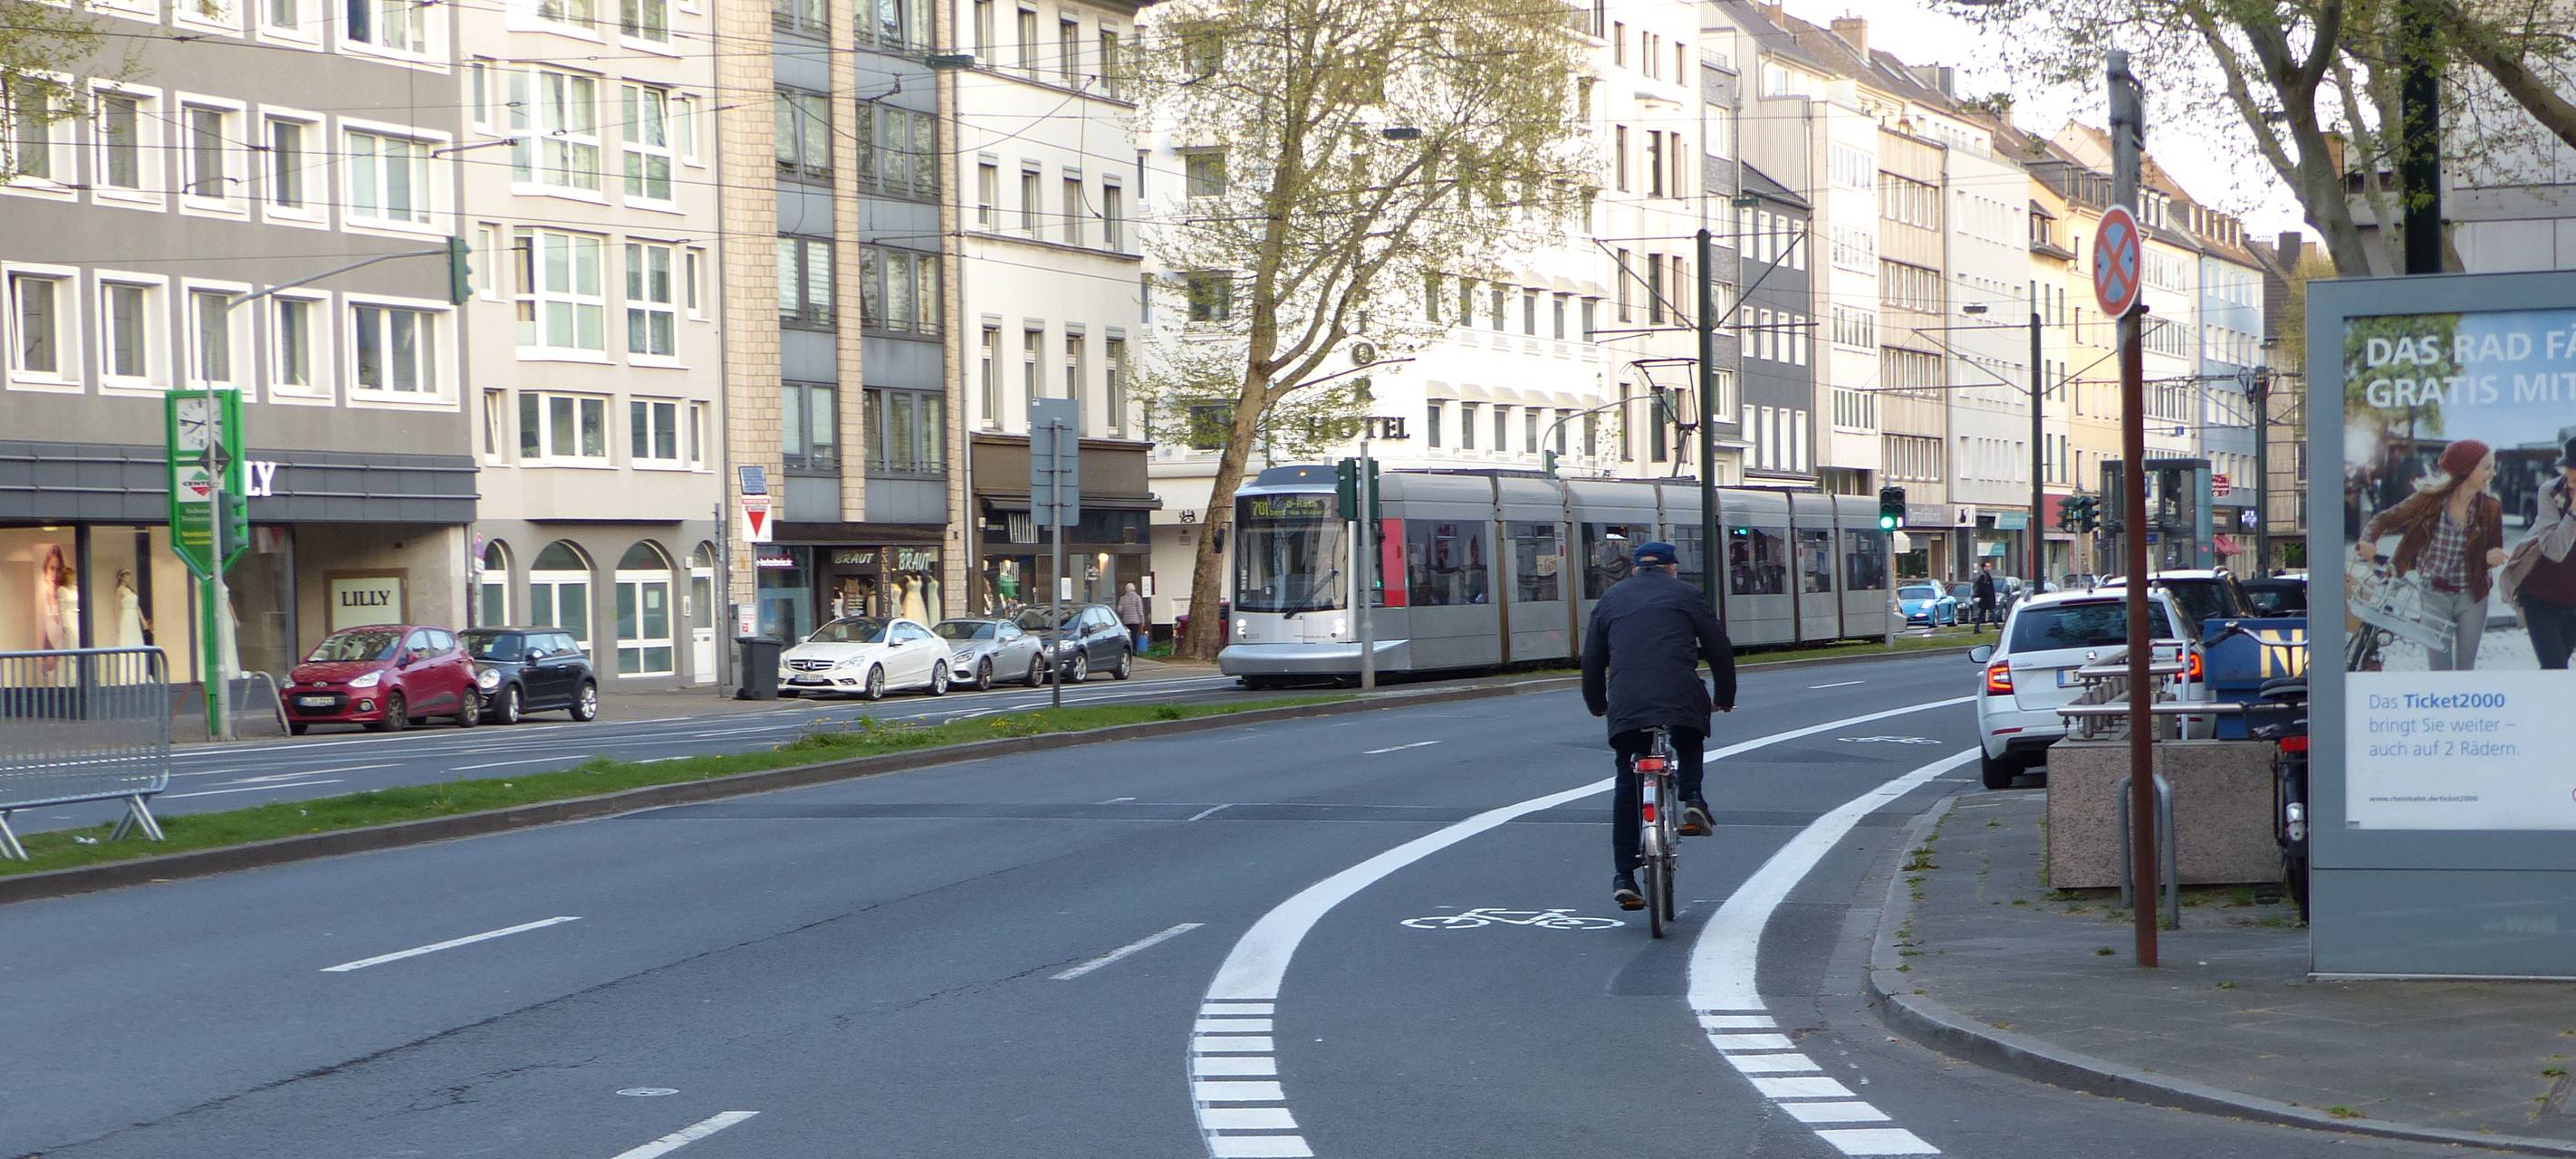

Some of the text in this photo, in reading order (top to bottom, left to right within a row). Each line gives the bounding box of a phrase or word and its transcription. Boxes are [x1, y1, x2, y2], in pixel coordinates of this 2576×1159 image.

[2367, 335, 2440, 368] DAS
[2454, 332, 2532, 362] RAD
[2367, 372, 2576, 407] GRATIS MIT
[1305, 416, 1410, 438] HOTEL
[1253, 501, 1268, 516] 701
[835, 553, 874, 564] BRAUT
[899, 552, 930, 570] BRAUT
[341, 590, 390, 607] LILLY
[2260, 628, 2310, 678] N
[2369, 693, 2505, 709] Das Ticket2000
[2369, 717, 2417, 737] bringt
[2422, 717, 2445, 733] Sie
[2450, 717, 2500, 733] weiter
[2369, 740, 2521, 757] auch auf 2 Rädern.
